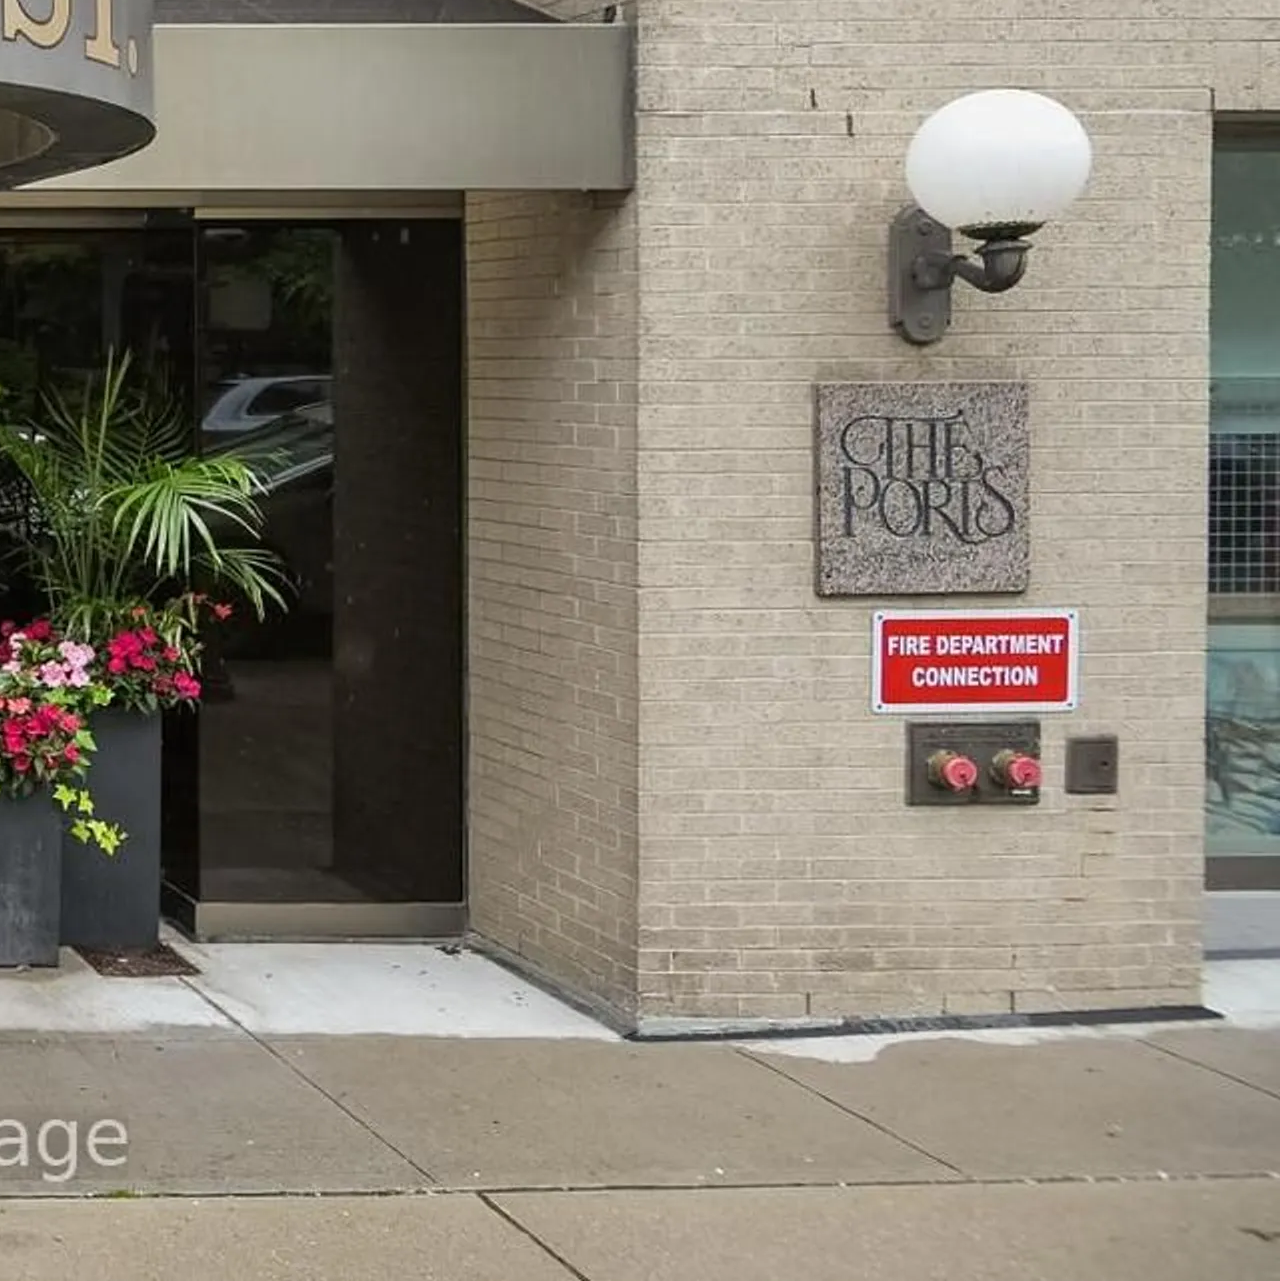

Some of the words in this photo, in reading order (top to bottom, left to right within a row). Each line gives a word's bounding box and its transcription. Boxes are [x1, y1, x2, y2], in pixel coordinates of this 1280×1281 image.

[840, 409, 984, 481] THE
[842, 465, 1016, 544] PORTS
[887, 636, 931, 656] FIRE
[936, 634, 1065, 656] DEPARTMENT
[911, 665, 1039, 687] CONNECTION
